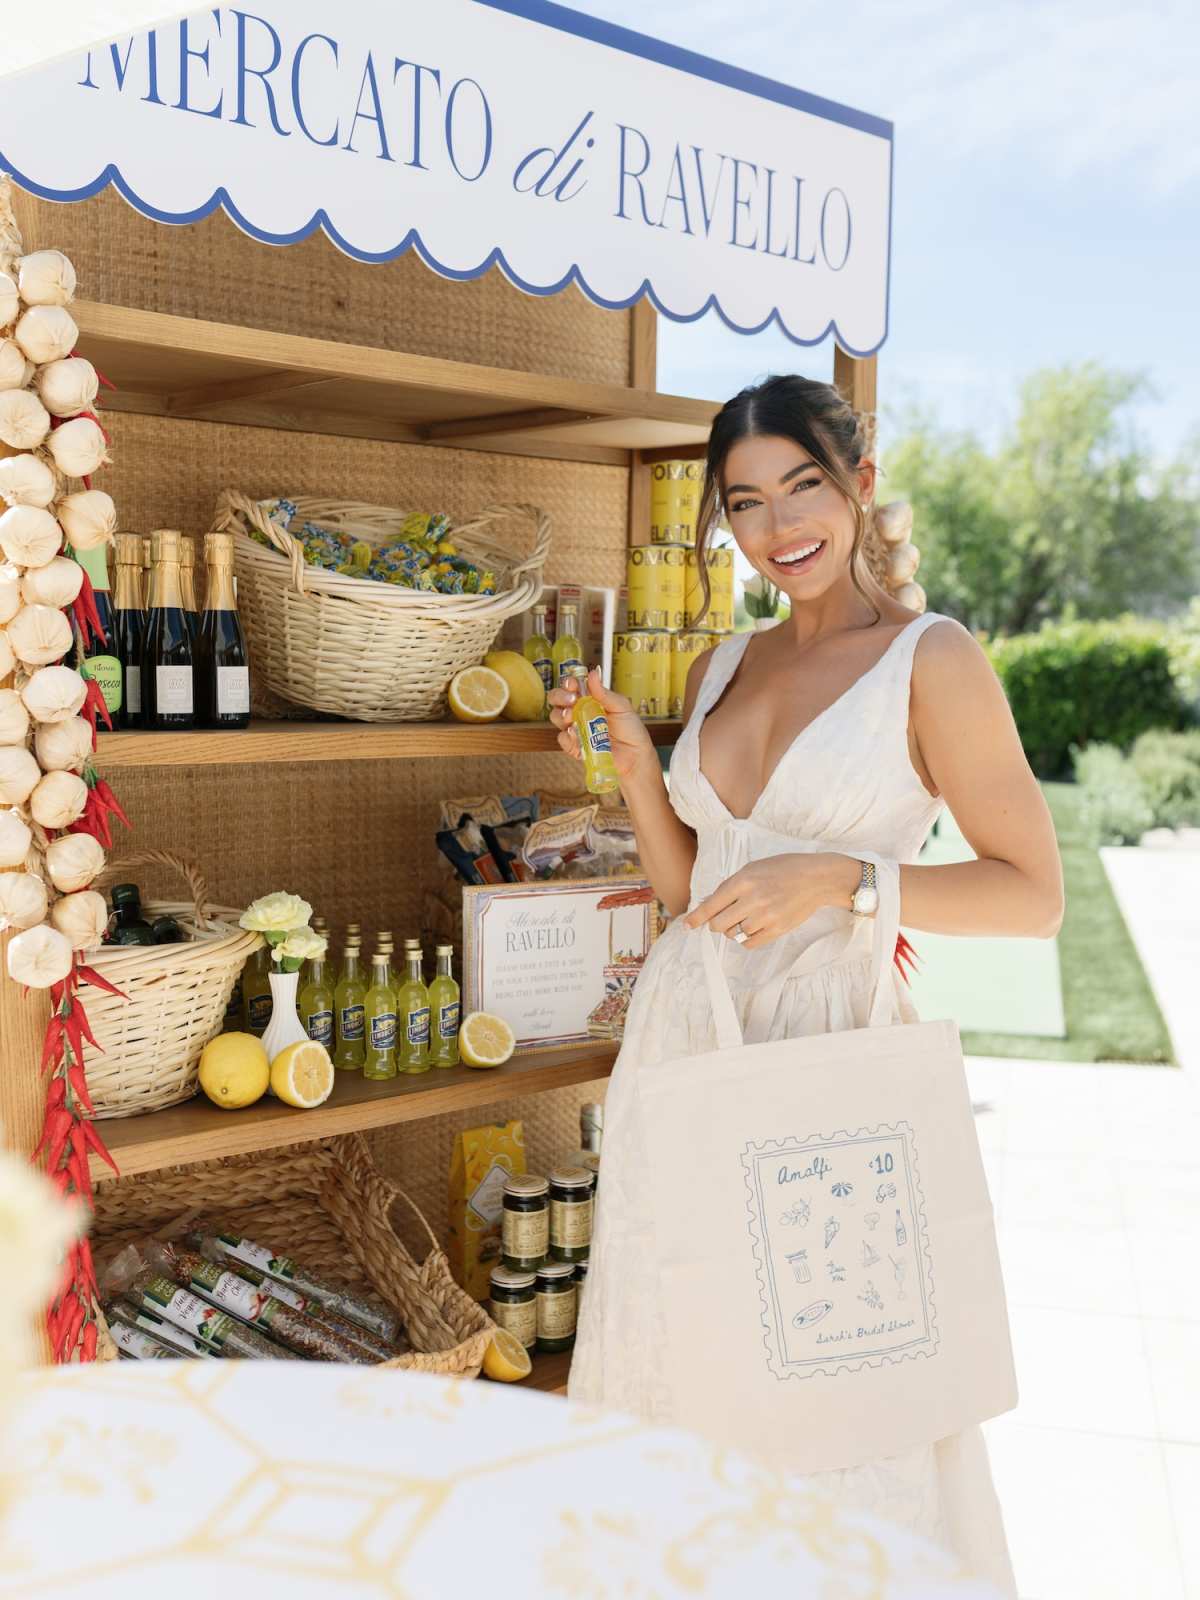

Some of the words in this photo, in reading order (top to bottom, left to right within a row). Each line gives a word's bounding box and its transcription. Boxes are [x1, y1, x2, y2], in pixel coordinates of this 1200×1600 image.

[513, 111, 594, 202] di
[613, 123, 852, 272] RAVELLO
[505, 927, 576, 953] RAVELLO
[856, 1322, 885, 1338] Bridal
